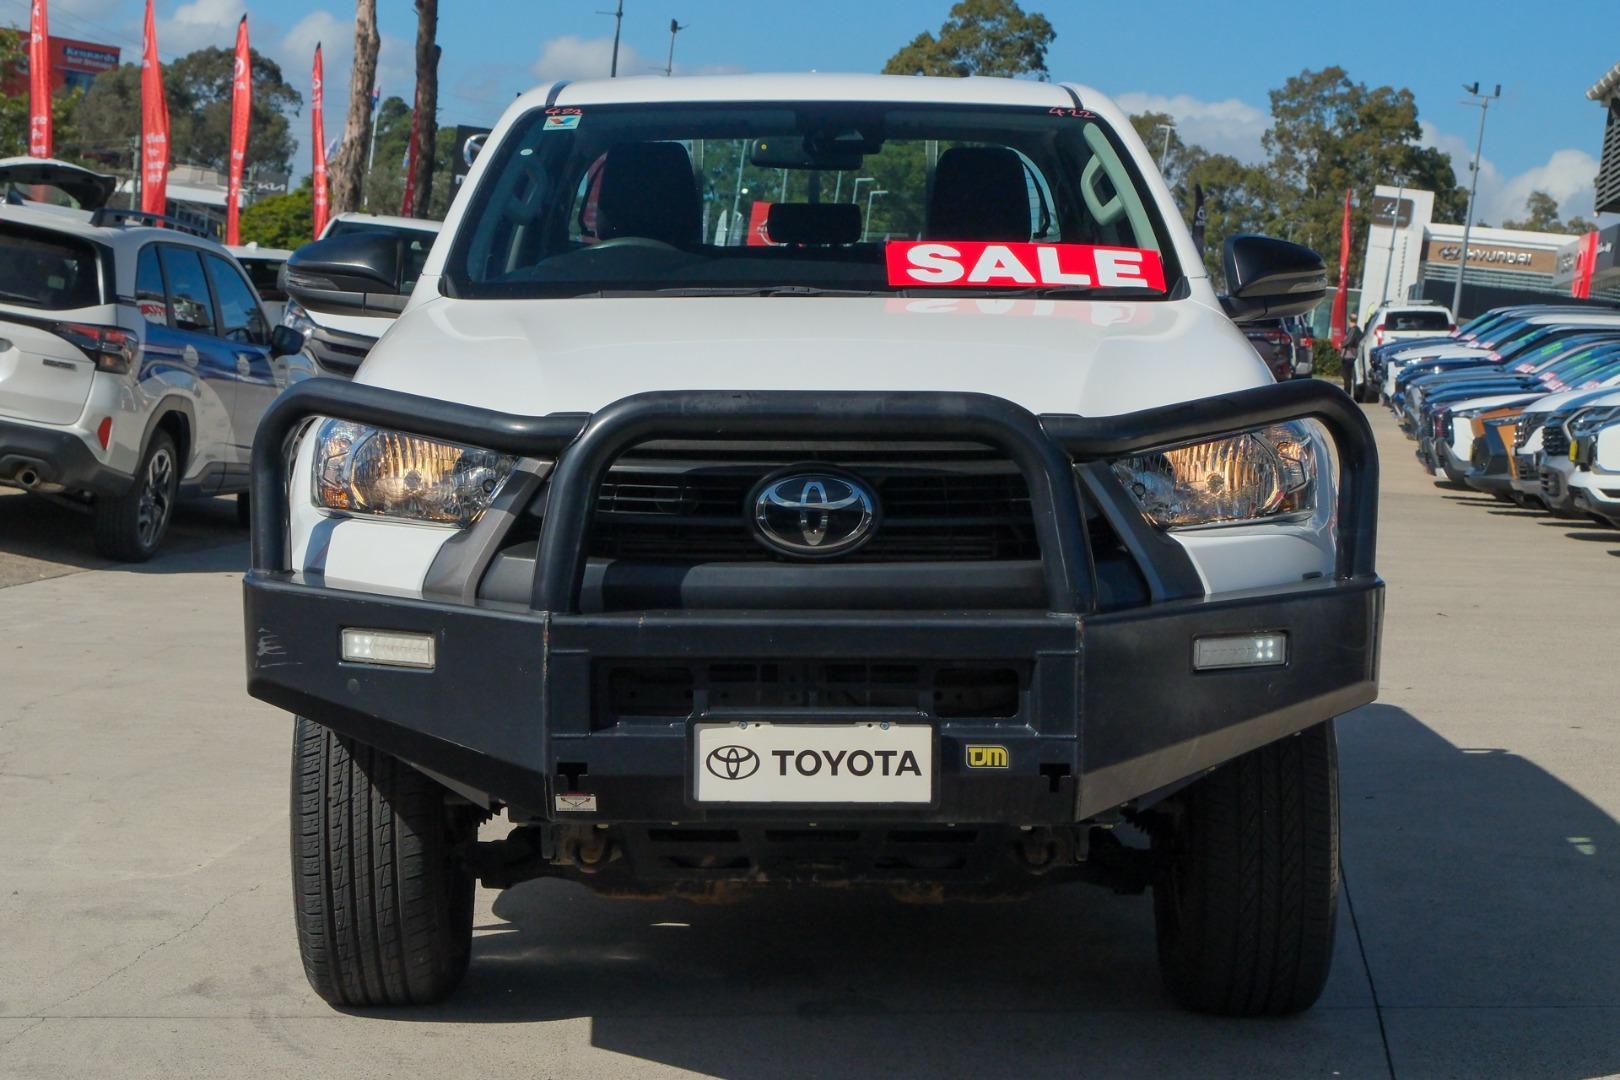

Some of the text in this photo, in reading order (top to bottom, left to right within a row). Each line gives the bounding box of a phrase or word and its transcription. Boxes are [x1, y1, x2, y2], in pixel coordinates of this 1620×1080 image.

[1048, 107, 1097, 118] 422
[906, 244, 1148, 287] SALE
[1466, 248, 1533, 266] HYUNDAI
[771, 749, 923, 777] TOYOTA
